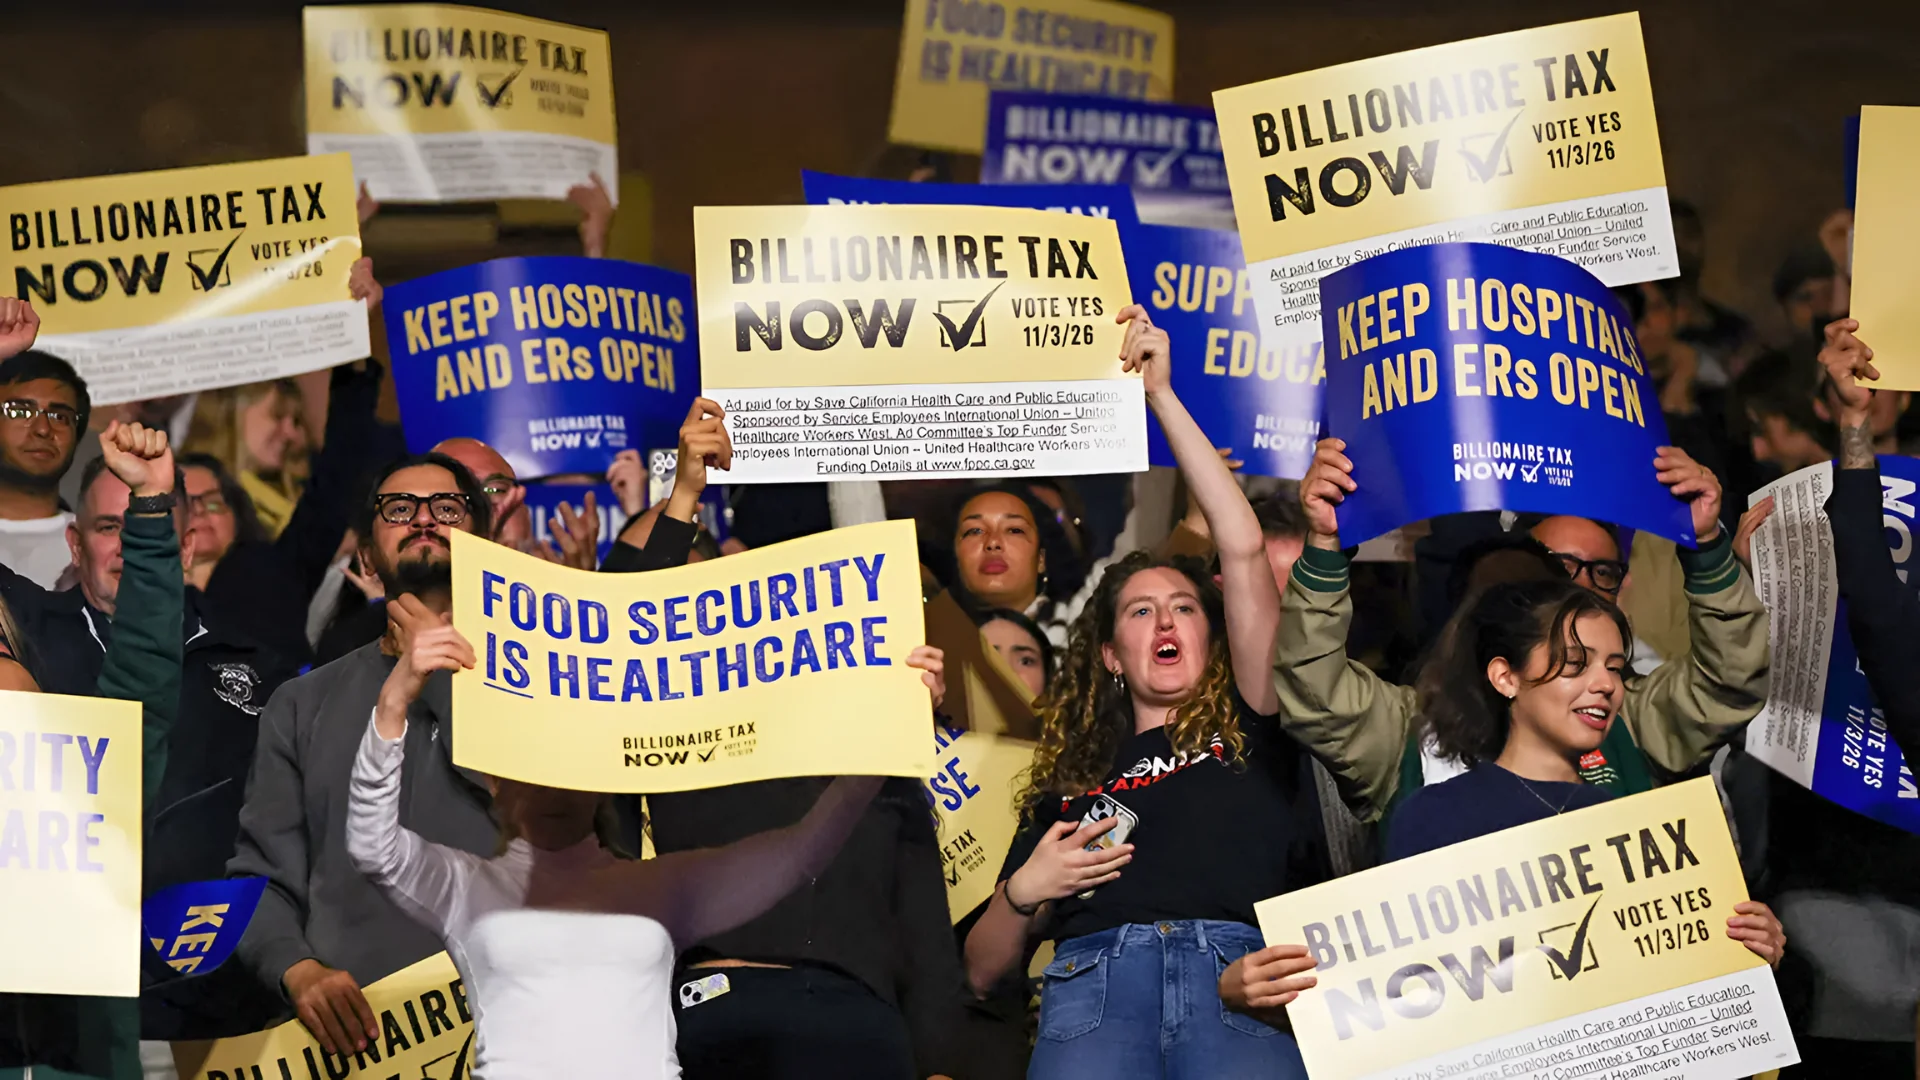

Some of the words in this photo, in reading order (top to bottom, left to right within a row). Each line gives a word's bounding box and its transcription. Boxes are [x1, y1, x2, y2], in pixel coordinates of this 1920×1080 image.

[331, 71, 462, 110] NOW
[1252, 62, 1526, 159] BILLIONAIRE
[1534, 47, 1617, 102] TAX
[1004, 104, 1189, 151] BILLIONAIRE
[1532, 117, 1580, 145] VOTE
[1586, 110, 1622, 135] YES
[1001, 144, 1127, 185] NOW
[1547, 139, 1616, 169] 11/3/26
[1264, 138, 1440, 222] NOW
[10, 190, 248, 252] BILLIONAIRE
[256, 182, 327, 225] TAX
[1557, 224, 1592, 240] Union
[1605, 216, 1644, 232] United
[251, 239, 292, 261] VOTE
[729, 235, 1009, 284] BILLIONAIRE
[1018, 236, 1098, 280] TAX
[1269, 268, 1287, 281] Ad
[1289, 261, 1315, 278] paid
[1318, 257, 1333, 270] for
[1336, 255, 1351, 268] by
[1490, 220, 1519, 235] Care
[1523, 214, 1545, 229] and
[1548, 209, 1584, 226] Public
[1574, 251, 1624, 266] Workers
[1603, 233, 1647, 247] Service
[14, 251, 170, 306] NOW
[403, 289, 500, 355] KEEP
[509, 283, 686, 343] HOSPITALS
[734, 298, 917, 352] NOW
[1011, 297, 1060, 319] VOTE
[1066, 297, 1104, 317] YES
[1337, 282, 1430, 360] KEEP
[1446, 277, 1645, 377] HOSPITALS
[1023, 324, 1094, 348] 11/3/26
[436, 343, 513, 402] AND
[521, 337, 594, 384] ERs
[599, 337, 675, 393] OPEN
[1362, 348, 1438, 421] AND
[1453, 344, 1539, 400] ERs
[1548, 352, 1646, 429] OPEN
[725, 399, 741, 411] Ad
[745, 398, 772, 412] paid
[775, 397, 791, 409] for
[796, 397, 810, 411] by
[814, 396, 845, 409] Save
[849, 394, 907, 408] California
[911, 393, 950, 407] Health
[955, 392, 984, 405] Care
[989, 392, 1011, 405] and
[1015, 391, 1053, 405] Public
[733, 413, 800, 429] Sponsored
[804, 413, 818, 427] by
[822, 410, 869, 425] Service
[872, 408, 940, 426] Employees
[944, 407, 1020, 422] International
[1023, 407, 1059, 420] Union
[531, 432, 581, 452] NOW
[731, 446, 790, 461] mployees
[794, 444, 870, 458] International
[873, 443, 909, 456] Union
[925, 442, 964, 454] United
[968, 440, 1035, 454] Healthcare
[1038, 438, 1090, 451] Workers
[733, 429, 800, 445] Healthcare
[803, 428, 855, 442] Workers
[896, 426, 913, 440] Ad
[917, 424, 993, 439] Committee's
[998, 424, 1019, 439] Top
[1023, 423, 1067, 437] Funder
[1071, 421, 1117, 434] Service
[1252, 432, 1304, 453] NOW
[817, 460, 866, 474] Funding
[870, 459, 912, 473] Details
[916, 459, 928, 472] at
[931, 457, 1035, 471] www.fppc.ca.gov
[1453, 441, 1545, 462] BILLIONAIRE
[1547, 446, 1573, 466] TAX
[1454, 461, 1516, 482] NOW
[1880, 475, 1917, 585] NO
[482, 569, 610, 645] FOOD
[628, 552, 886, 646] SECURITY
[486, 632, 530, 689] IS
[548, 615, 892, 703] HEALTHCARE
[623, 728, 722, 750] BILLIONAIRE
[728, 721, 757, 738] TAX
[1841, 704, 1866, 770] 11/3/26
[624, 750, 690, 767] NOW
[1863, 755, 1885, 789] YES
[926, 756, 981, 811] SE
[951, 828, 977, 854] TAX
[1302, 843, 1604, 972] BILLIONAIRE
[1606, 818, 1700, 884] TAX
[1613, 900, 1669, 932] VOTE
[1670, 886, 1713, 917] YES
[1633, 919, 1710, 959] 11/3/26
[1323, 935, 1516, 1041] NOW
[1435, 1060, 1469, 1078] Save
[1472, 1040, 1536, 1066] California
[1537, 1028, 1580, 1047] Health
[1583, 1019, 1615, 1036] Care
[1618, 1010, 1643, 1027] and
[1645, 1000, 1686, 1020] Public
[1501, 1047, 1574, 1077] Employees
[1576, 1024, 1656, 1057] International
[1659, 1015, 1697, 1034] Union
[1710, 1000, 1753, 1020] United
[1636, 1044, 1660, 1057] Top
[1663, 1030, 1710, 1051] Funder
[1711, 1016, 1759, 1038] Service
[1683, 1043, 1737, 1063] Workers
